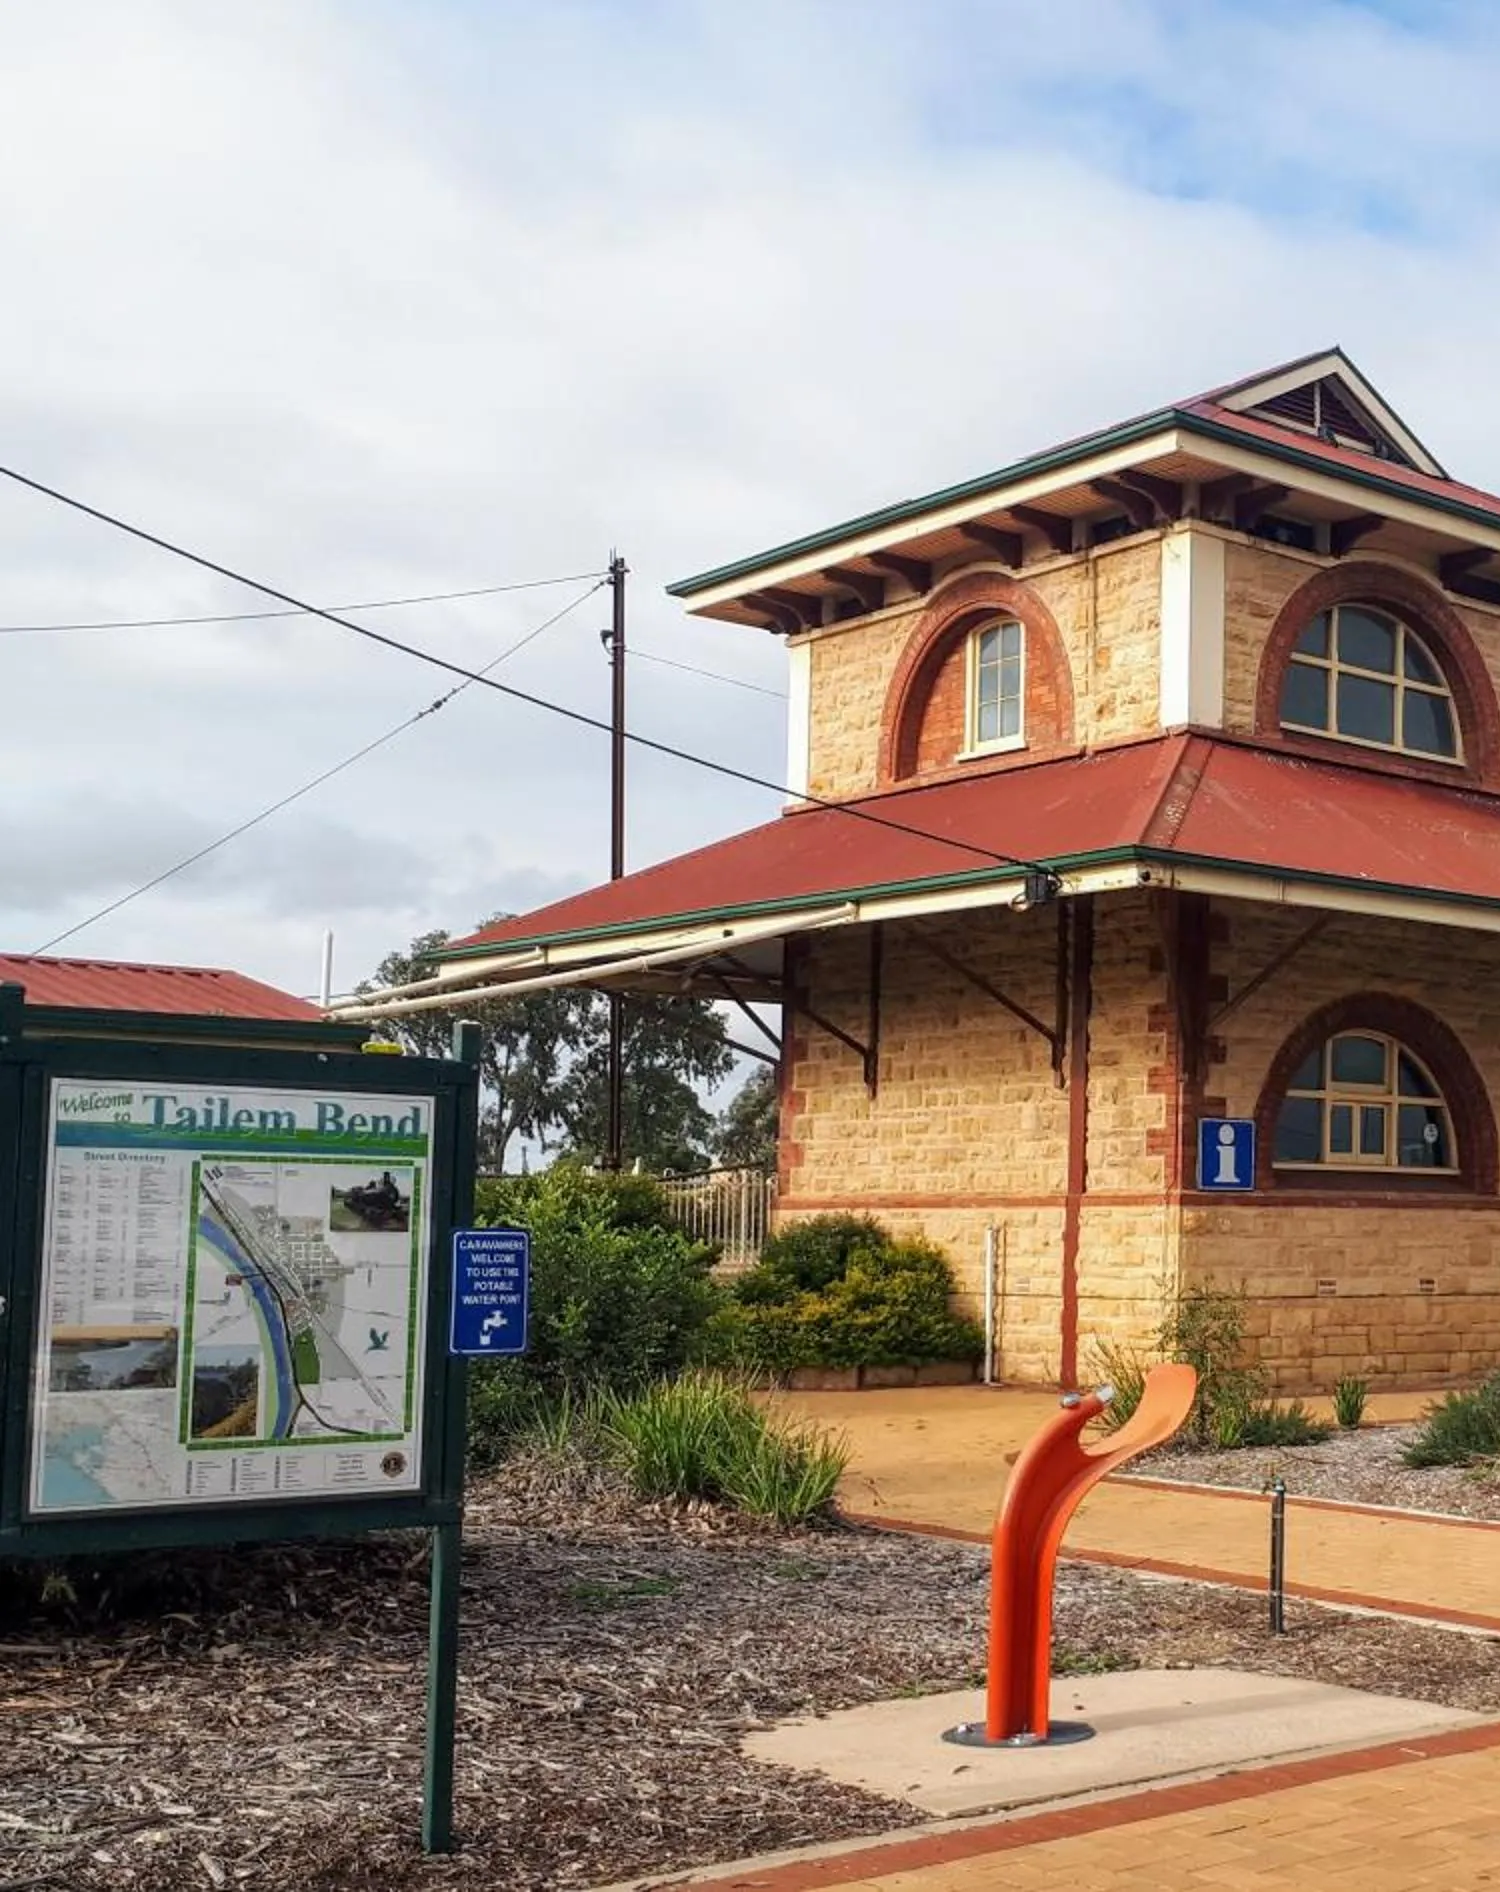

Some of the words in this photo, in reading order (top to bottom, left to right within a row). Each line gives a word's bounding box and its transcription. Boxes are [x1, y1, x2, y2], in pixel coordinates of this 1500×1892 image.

[59, 1092, 133, 1113] Welcome
[113, 1112, 131, 1124] to
[143, 1095, 297, 1138] Tailem
[313, 1101, 422, 1141] Bend
[470, 1253, 516, 1264] WELCOME
[466, 1267, 480, 1277] TO
[481, 1267, 501, 1277] USE
[461, 1294, 498, 1305] WATER
